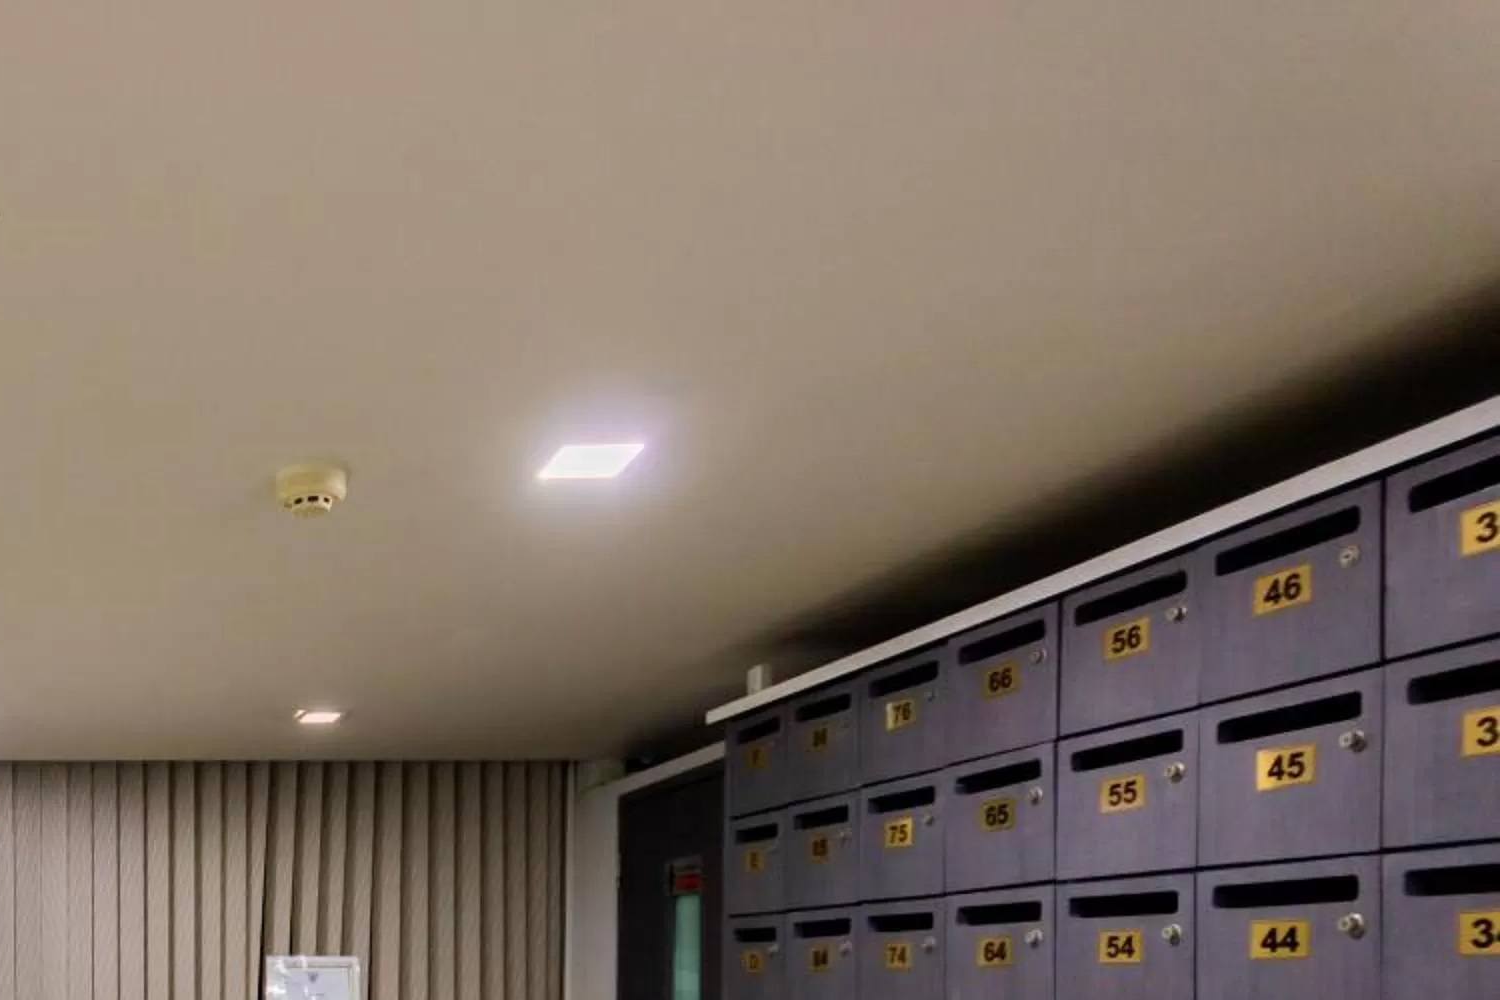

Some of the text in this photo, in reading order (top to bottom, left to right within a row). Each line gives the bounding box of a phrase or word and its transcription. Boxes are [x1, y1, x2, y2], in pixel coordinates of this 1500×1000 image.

[1475, 511, 1500, 543] 3
[1263, 574, 1302, 606] 46
[1110, 626, 1142, 655] 56
[988, 667, 1013, 693] 66
[892, 701, 913, 723] 76
[1475, 716, 1500, 748] 3
[1267, 751, 1306, 782] 45
[1108, 778, 1138, 807] 55
[985, 803, 1009, 827] 65
[888, 824, 909, 845] 75
[1107, 935, 1136, 959] 54
[1261, 925, 1300, 953] 44
[1469, 917, 1500, 949] 3
[886, 947, 907, 965] 74
[983, 941, 1008, 962] 64
